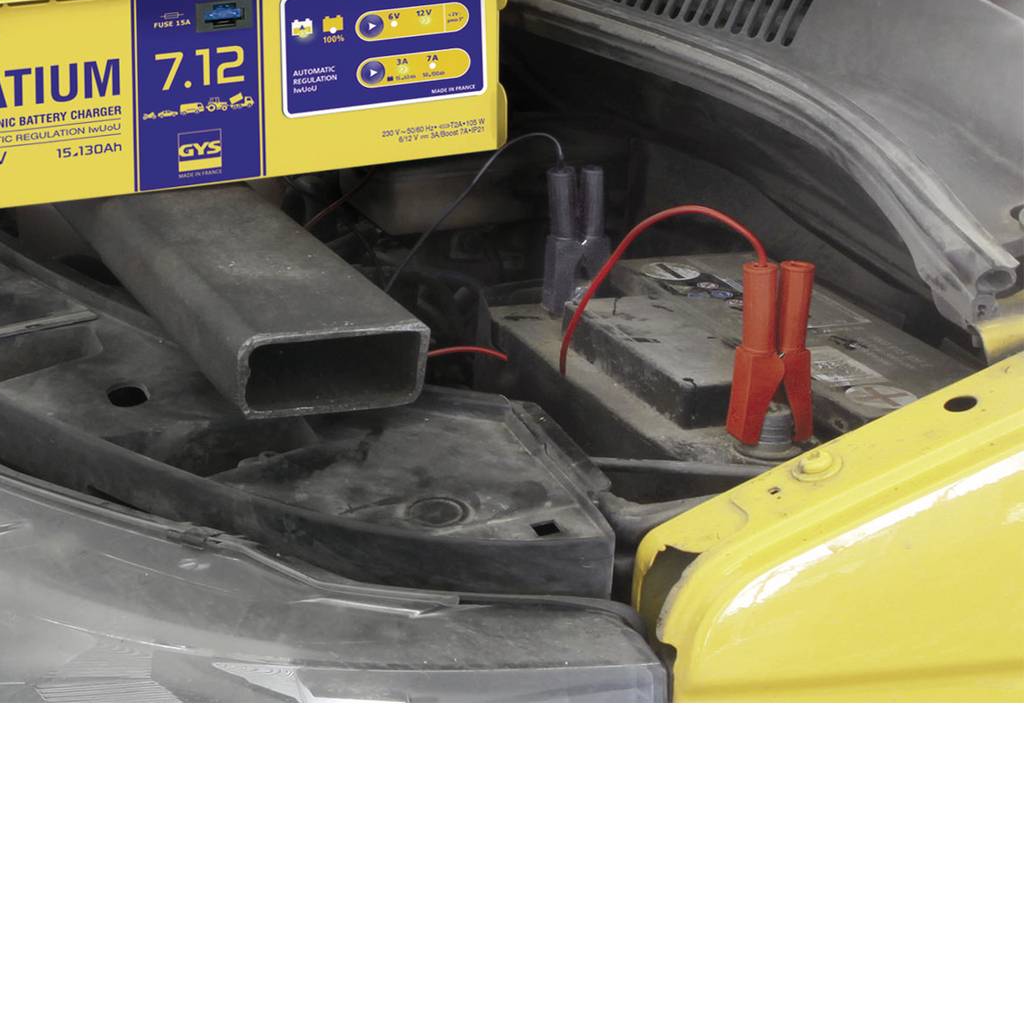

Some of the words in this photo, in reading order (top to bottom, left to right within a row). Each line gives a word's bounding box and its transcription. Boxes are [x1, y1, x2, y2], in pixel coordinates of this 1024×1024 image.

[153, 20, 174, 29] FUSE
[176, 18, 191, 27] 15A
[322, 34, 345, 44] 100%
[154, 45, 245, 91] 7.12
[293, 66, 336, 77] AUTOMATIC
[293, 74, 338, 86] REGULATION
[19, 111, 68, 127] BATTERY
[70, 105, 122, 120] CHARGER
[15, 127, 85, 142] REGULATION
[178, 140, 222, 158] GYS
[178, 170, 194, 178] MADE
[201, 166, 222, 176] FRANCE
